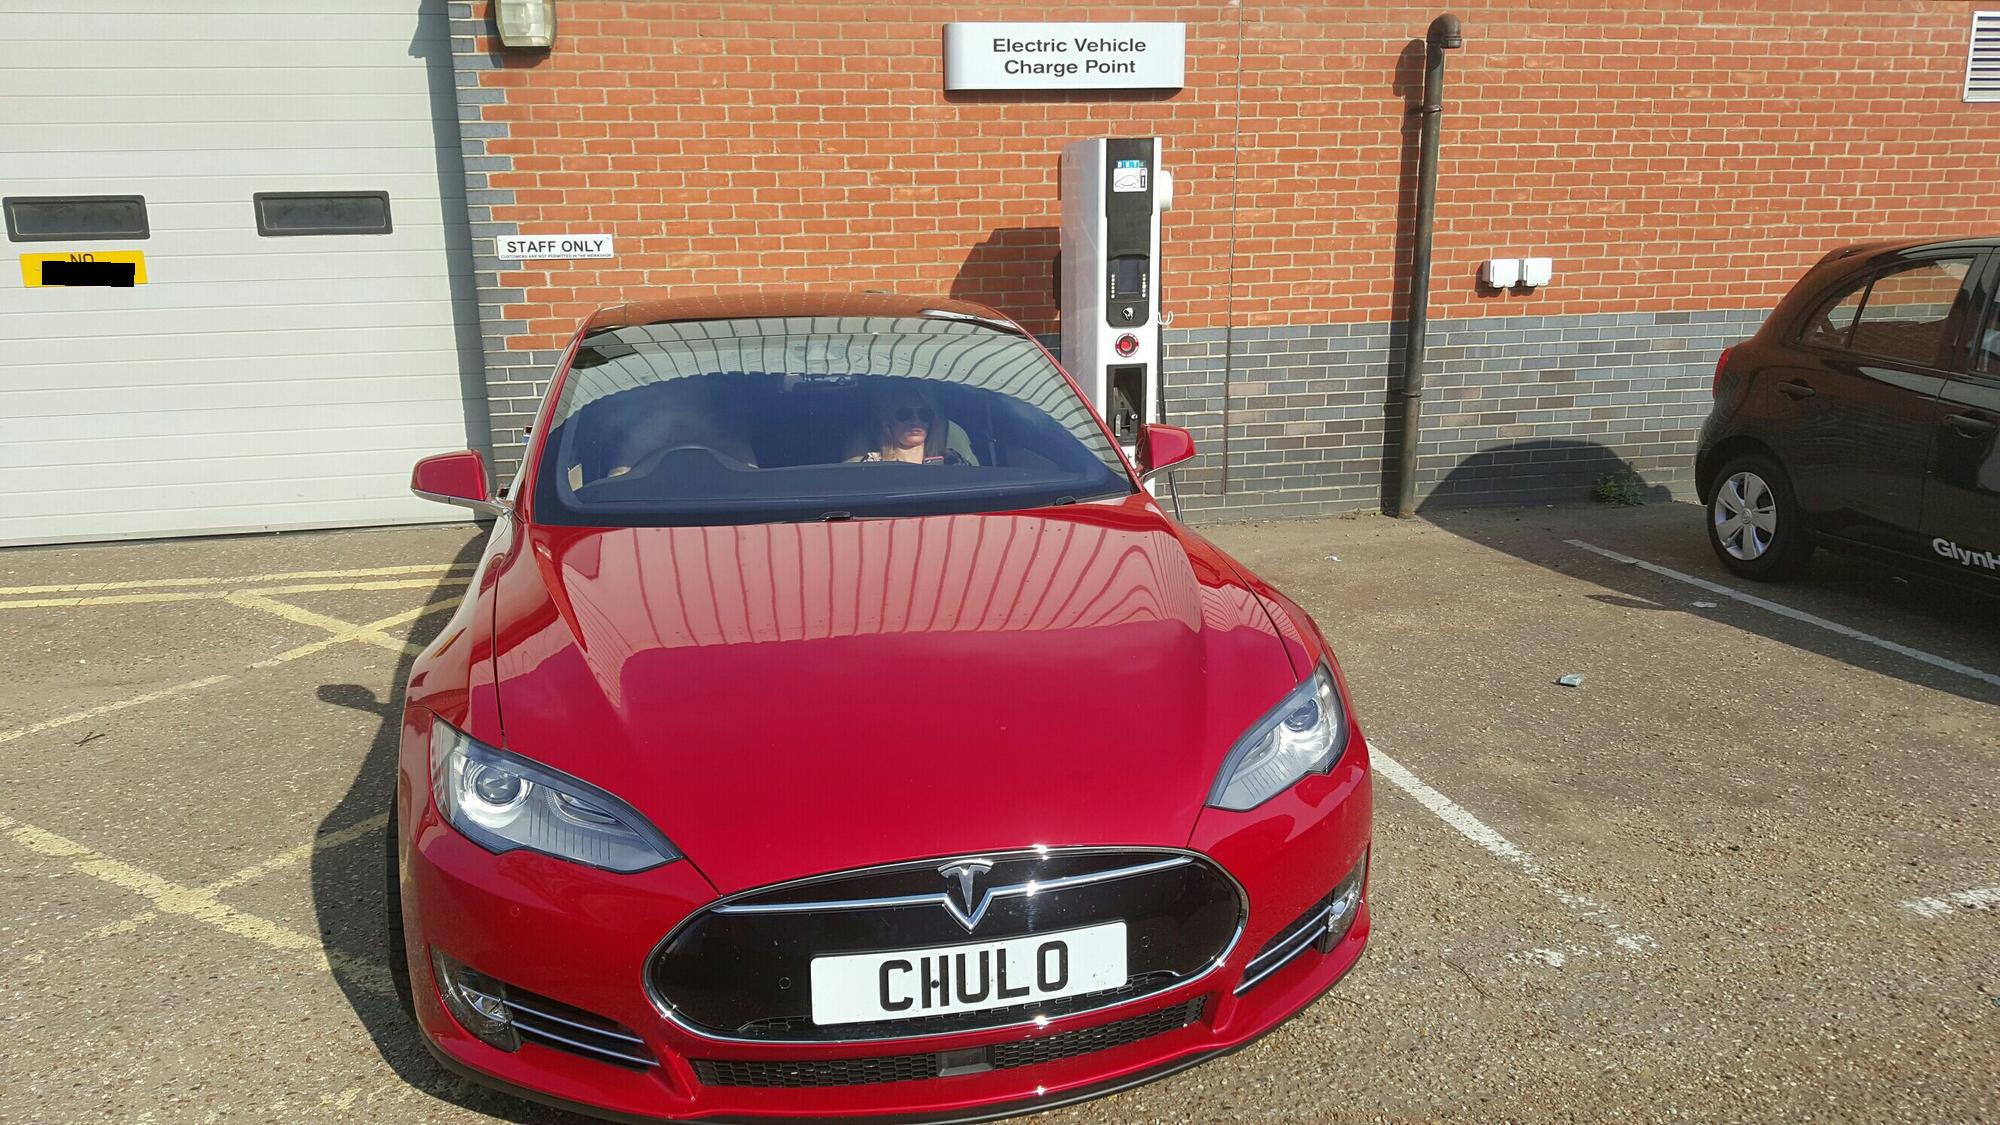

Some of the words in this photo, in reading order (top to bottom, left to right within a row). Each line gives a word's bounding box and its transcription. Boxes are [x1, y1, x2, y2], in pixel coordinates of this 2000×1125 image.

[993, 38, 1067, 52] Electric
[1074, 38, 1147, 52] Vehicle
[1004, 59, 1078, 77] Charge
[1085, 59, 1136, 73] Point
[507, 241, 556, 253] STAFF
[561, 240, 603, 252] ONLY
[879, 940, 1069, 1012] CHULO
